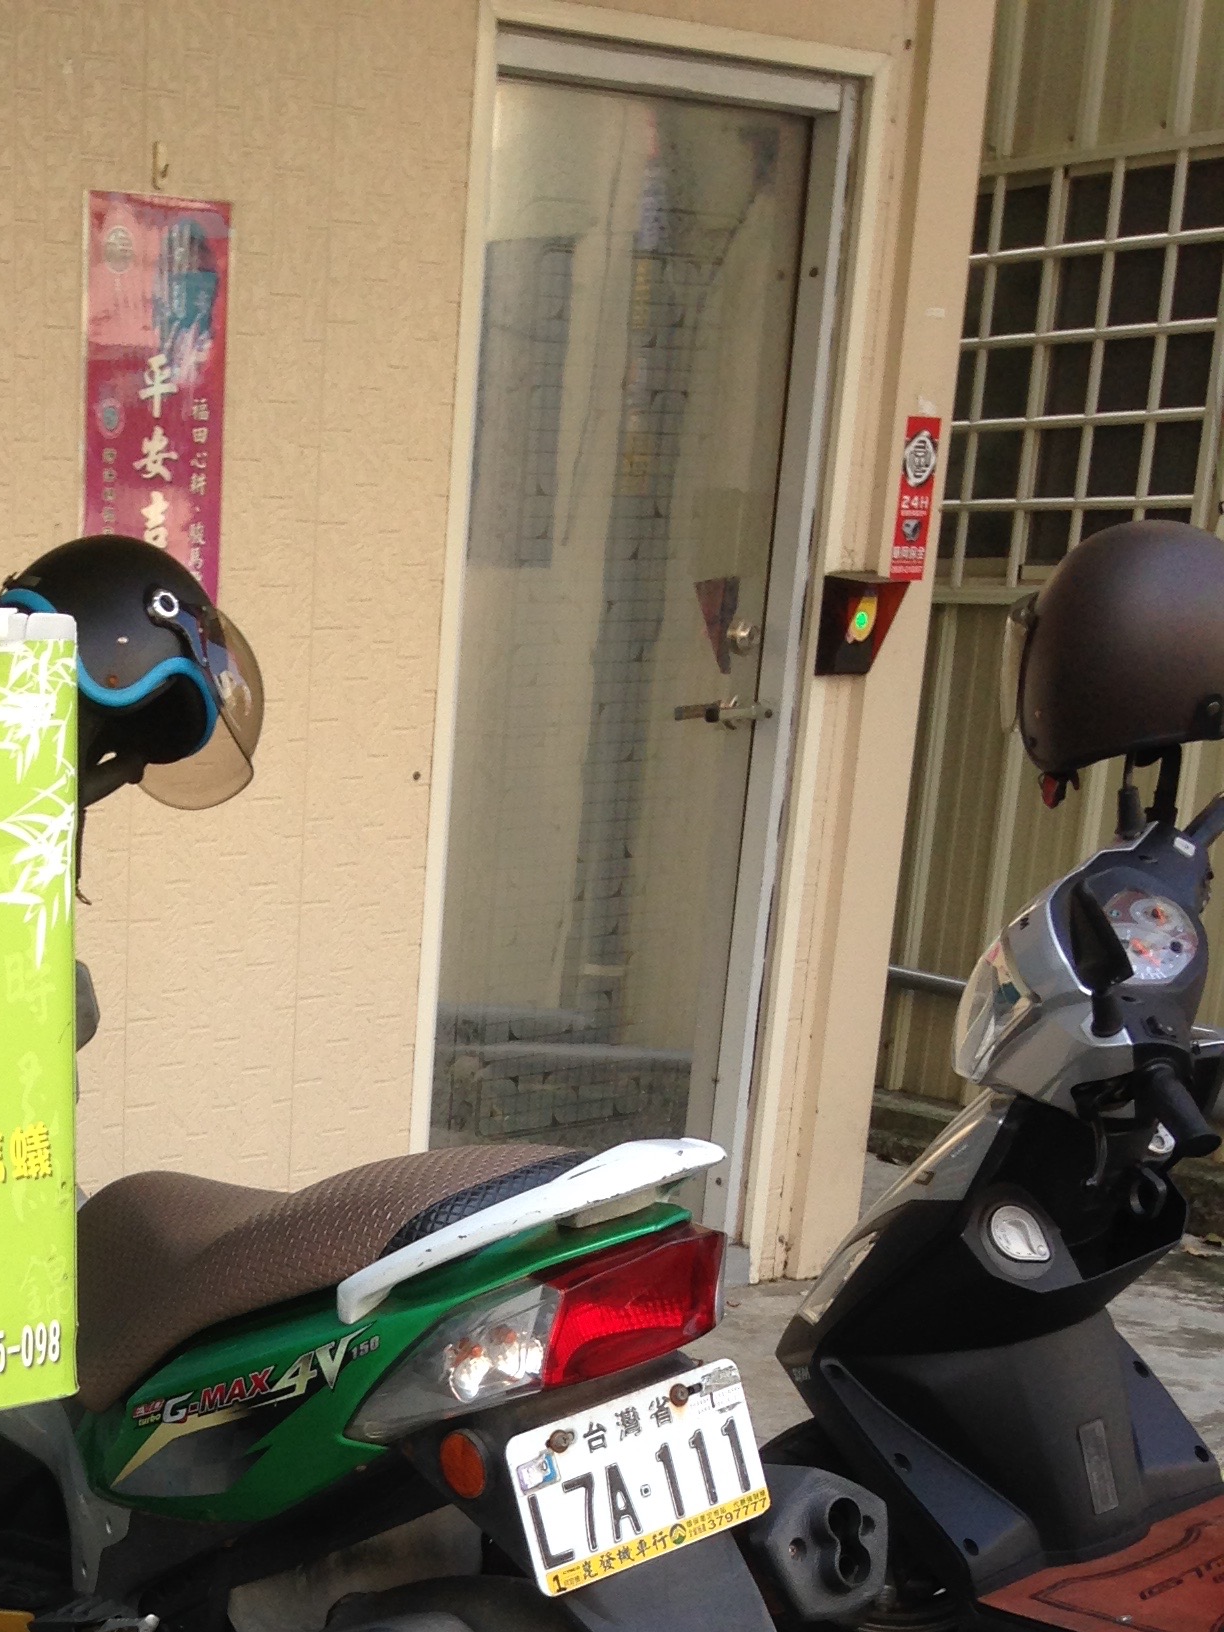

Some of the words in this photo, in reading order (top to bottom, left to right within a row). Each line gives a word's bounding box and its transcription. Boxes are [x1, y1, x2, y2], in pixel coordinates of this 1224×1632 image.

[900, 496, 930, 510] 24H
[162, 1366, 275, 1424] G-MAX
[256, 1320, 377, 1404] 4V
[138, 1412, 162, 1427] turbo
[583, 1396, 674, 1454] 台灣省
[708, 1498, 768, 1531] 3797777
